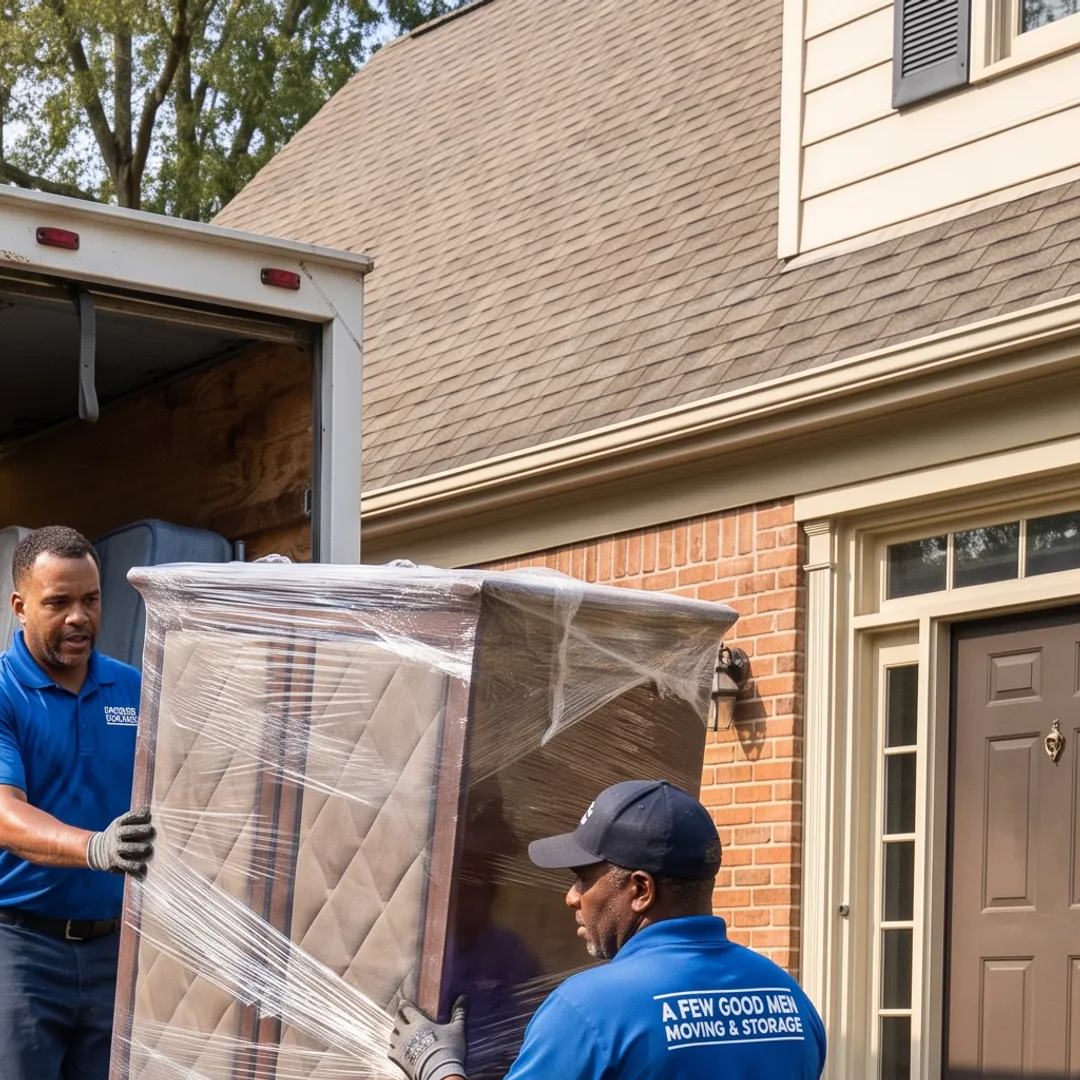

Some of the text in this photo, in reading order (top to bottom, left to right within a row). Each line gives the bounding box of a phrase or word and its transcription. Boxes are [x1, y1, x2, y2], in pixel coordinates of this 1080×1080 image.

[662, 995, 799, 1022] A FEW GOOD MEN
[665, 1017, 803, 1042] MOVING & STORAGE
